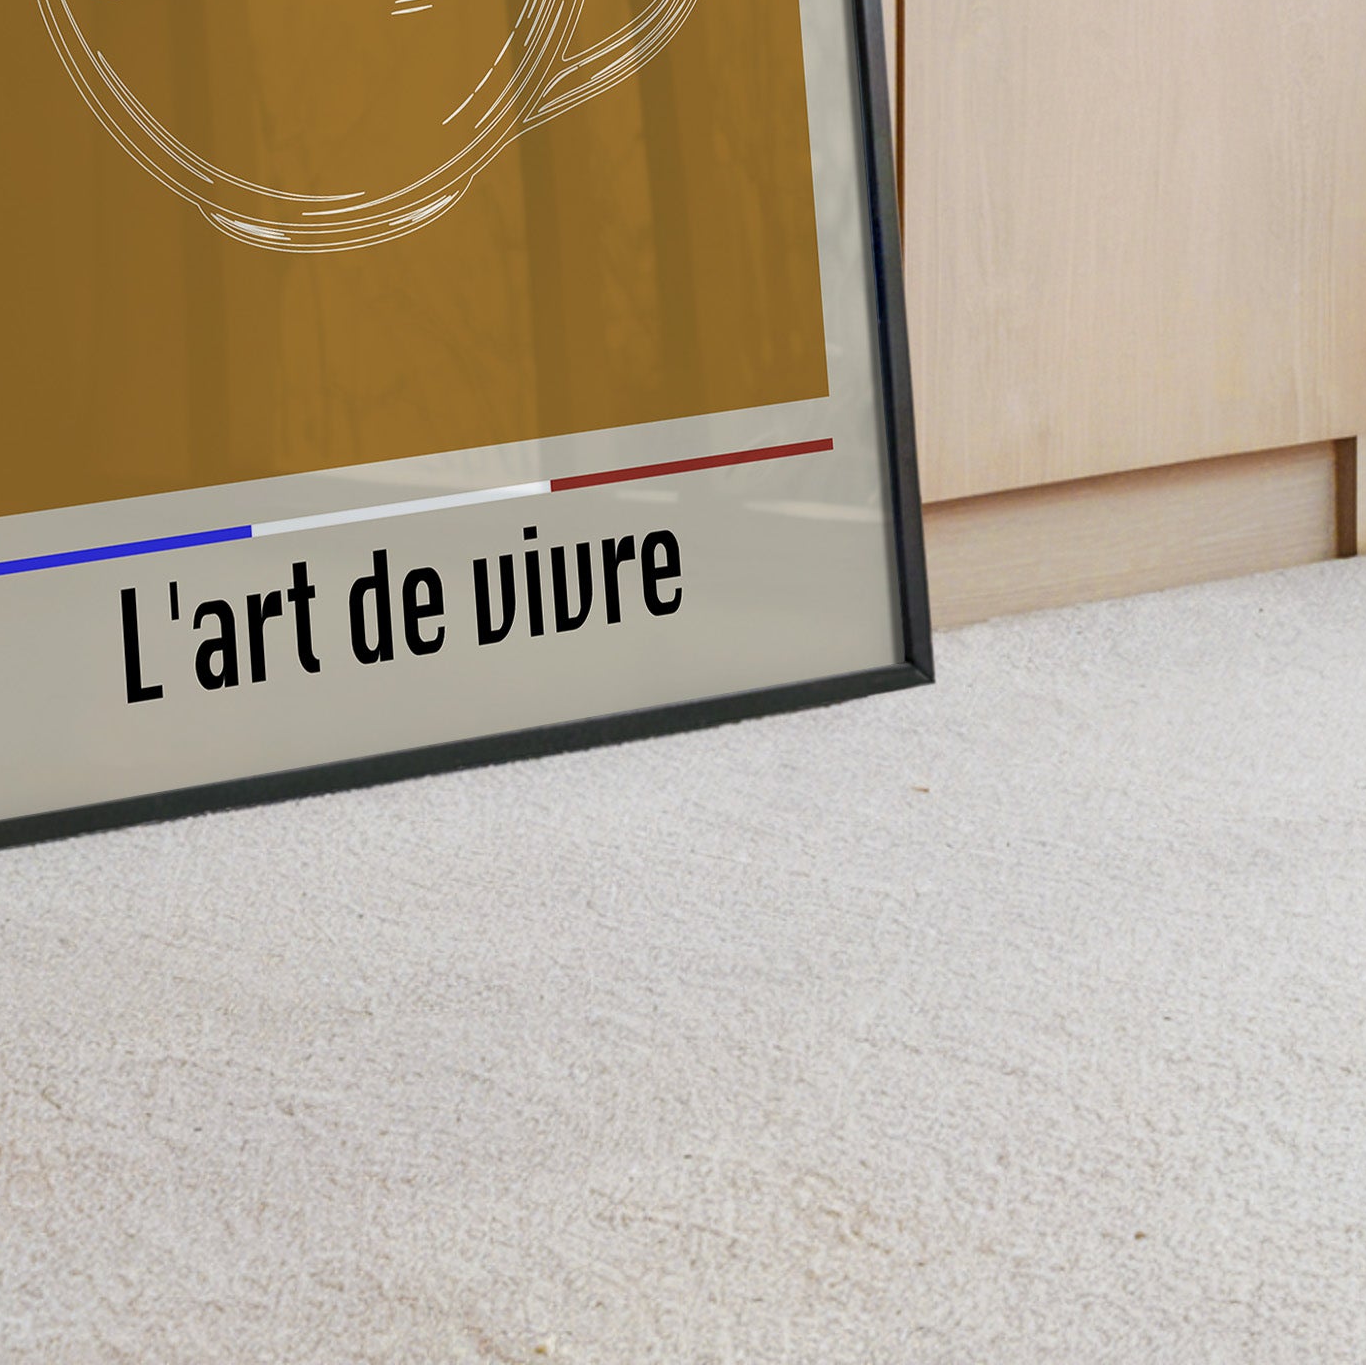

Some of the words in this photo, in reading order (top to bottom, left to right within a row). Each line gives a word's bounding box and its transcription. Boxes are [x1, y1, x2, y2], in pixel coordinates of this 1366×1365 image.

[120, 561, 321, 704] L'art
[348, 548, 446, 665] de
[472, 525, 684, 646] vivre
